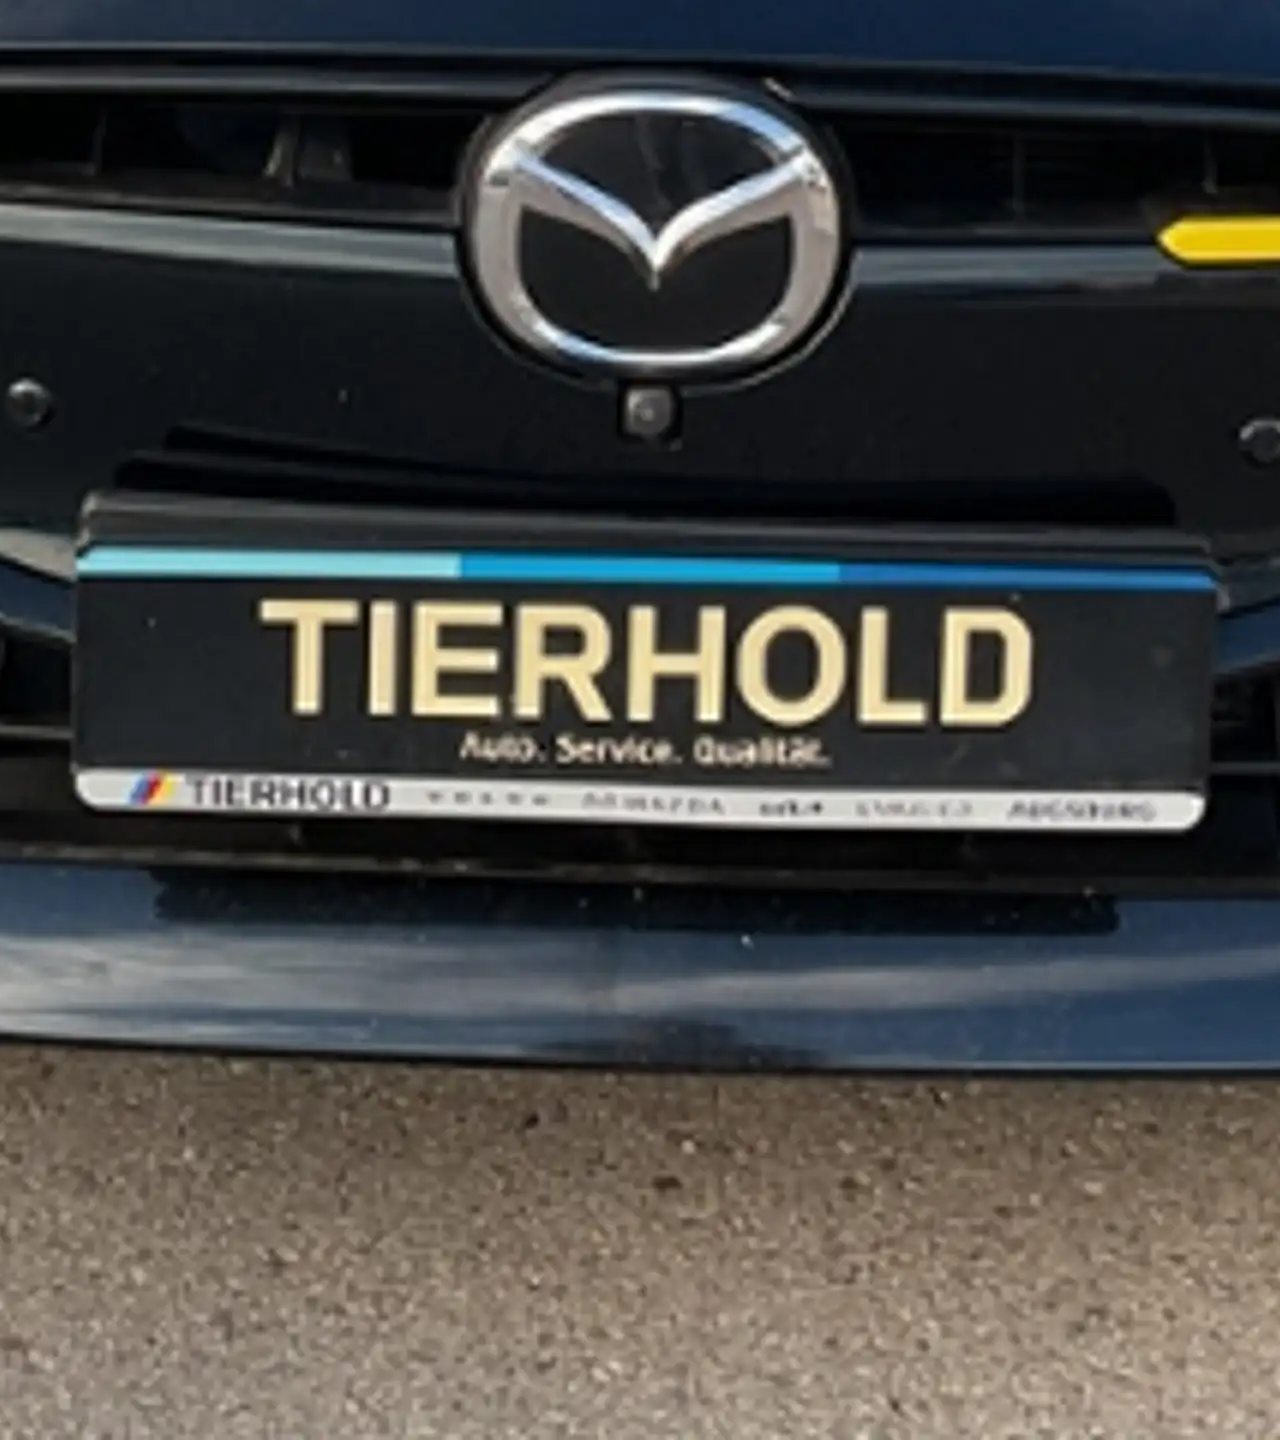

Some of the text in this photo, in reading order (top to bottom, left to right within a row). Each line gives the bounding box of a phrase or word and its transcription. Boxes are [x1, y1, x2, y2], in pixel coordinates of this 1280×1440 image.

[258, 597, 1035, 728] TIERHOLD
[458, 731, 546, 761] Auto.
[554, 733, 683, 766] Service.
[186, 774, 391, 814] TIERHOLD
